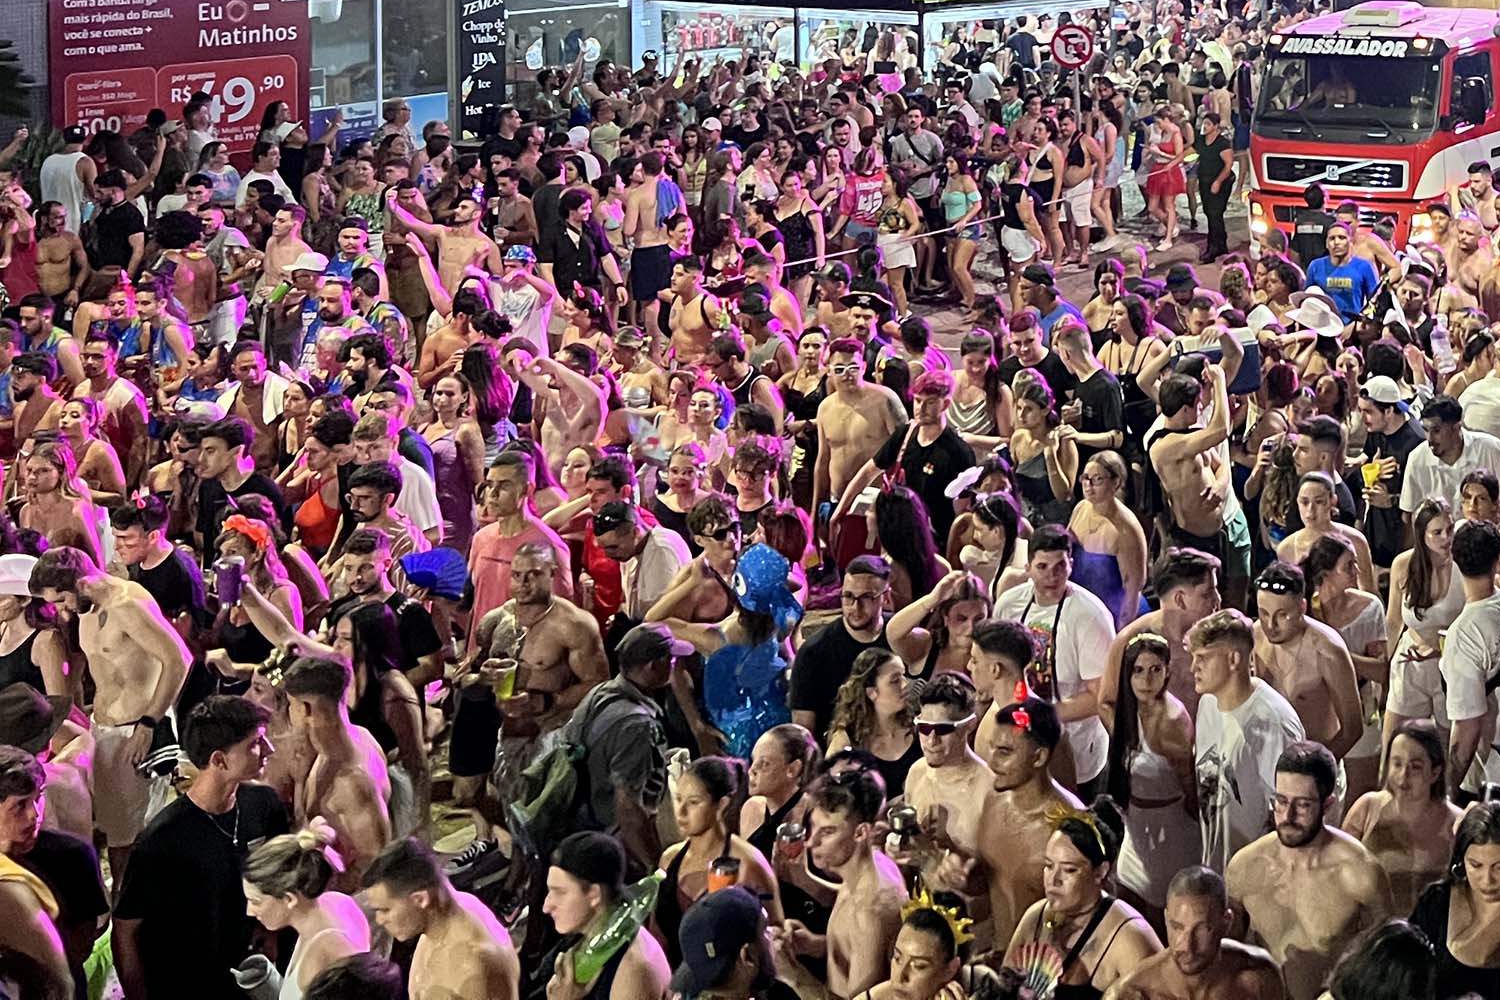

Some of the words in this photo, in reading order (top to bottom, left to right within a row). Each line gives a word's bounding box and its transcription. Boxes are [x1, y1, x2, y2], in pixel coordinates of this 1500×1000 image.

[63, 0, 88, 8] Com
[89, 0, 96, 7] a
[64, 16, 90, 24] mais
[91, 11, 125, 24] rápida
[126, 10, 141, 20] do
[142, 8, 174, 19] Brasil,
[199, 3, 223, 21] Eu
[64, 29, 89, 40] você
[90, 30, 102, 39] se
[103, 26, 144, 37] conecta
[462, 20, 493, 33] Chopp
[494, 18, 505, 29] de
[199, 23, 298, 48] Matinhos
[471, 33, 499, 44] Vinho
[64, 46, 88, 56] com
[88, 46, 96, 54] o
[97, 44, 118, 55] que
[119, 42, 145, 52] ama.
[1281, 37, 1408, 58] AVASSALADOR
[472, 52, 497, 72] IPA
[478, 79, 491, 89] Ice
[171, 84, 193, 104] R$
[465, 106, 483, 116] Hot
